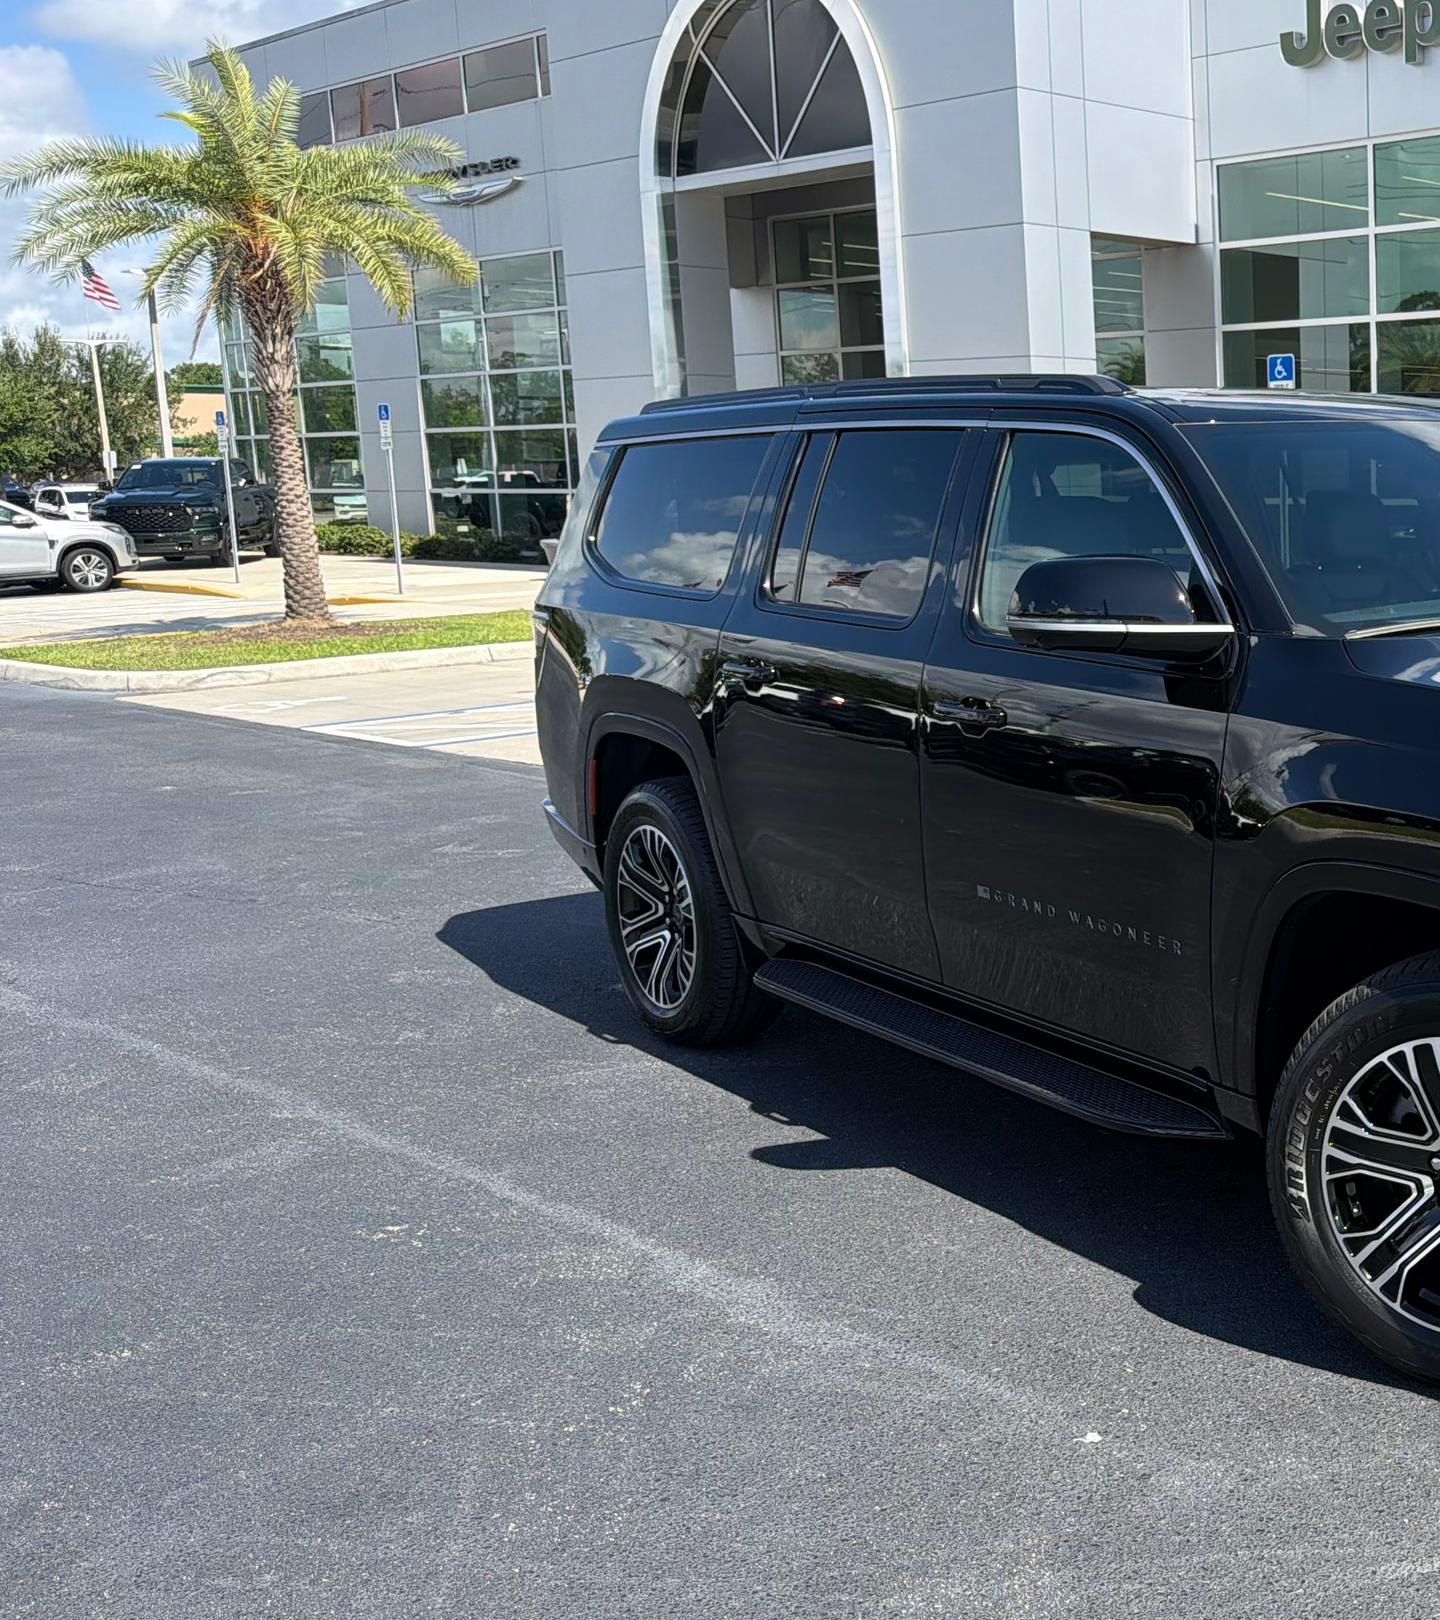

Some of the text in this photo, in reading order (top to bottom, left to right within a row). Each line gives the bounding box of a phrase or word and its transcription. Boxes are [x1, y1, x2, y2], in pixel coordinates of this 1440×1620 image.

[421, 156, 520, 179] YSLER
[994, 890, 1184, 956] GRAND WAGONEER
